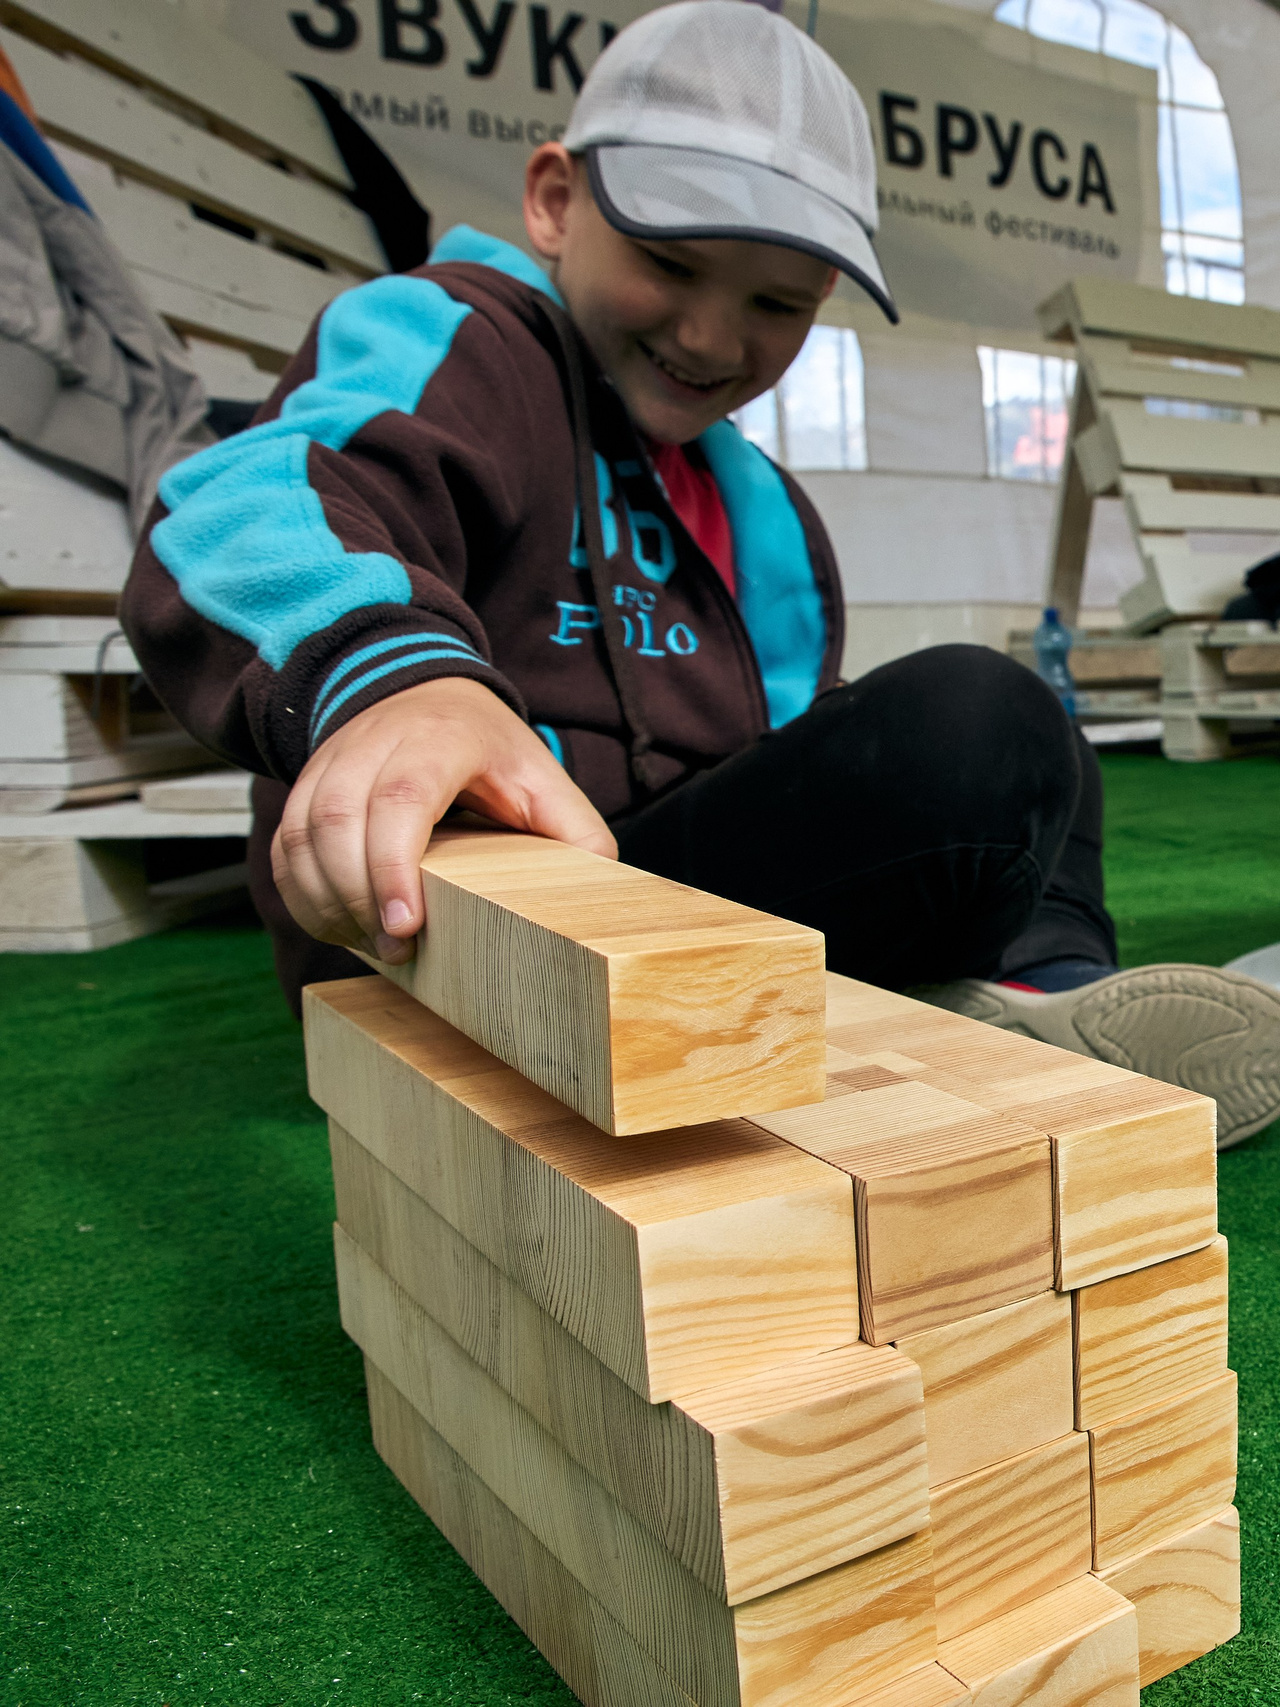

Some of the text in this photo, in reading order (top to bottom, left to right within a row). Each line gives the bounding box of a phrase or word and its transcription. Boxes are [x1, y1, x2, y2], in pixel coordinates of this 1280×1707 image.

[287, 0, 1116, 214] ЗВУК БРУСА
[984, 207, 1120, 260] фестиваль
